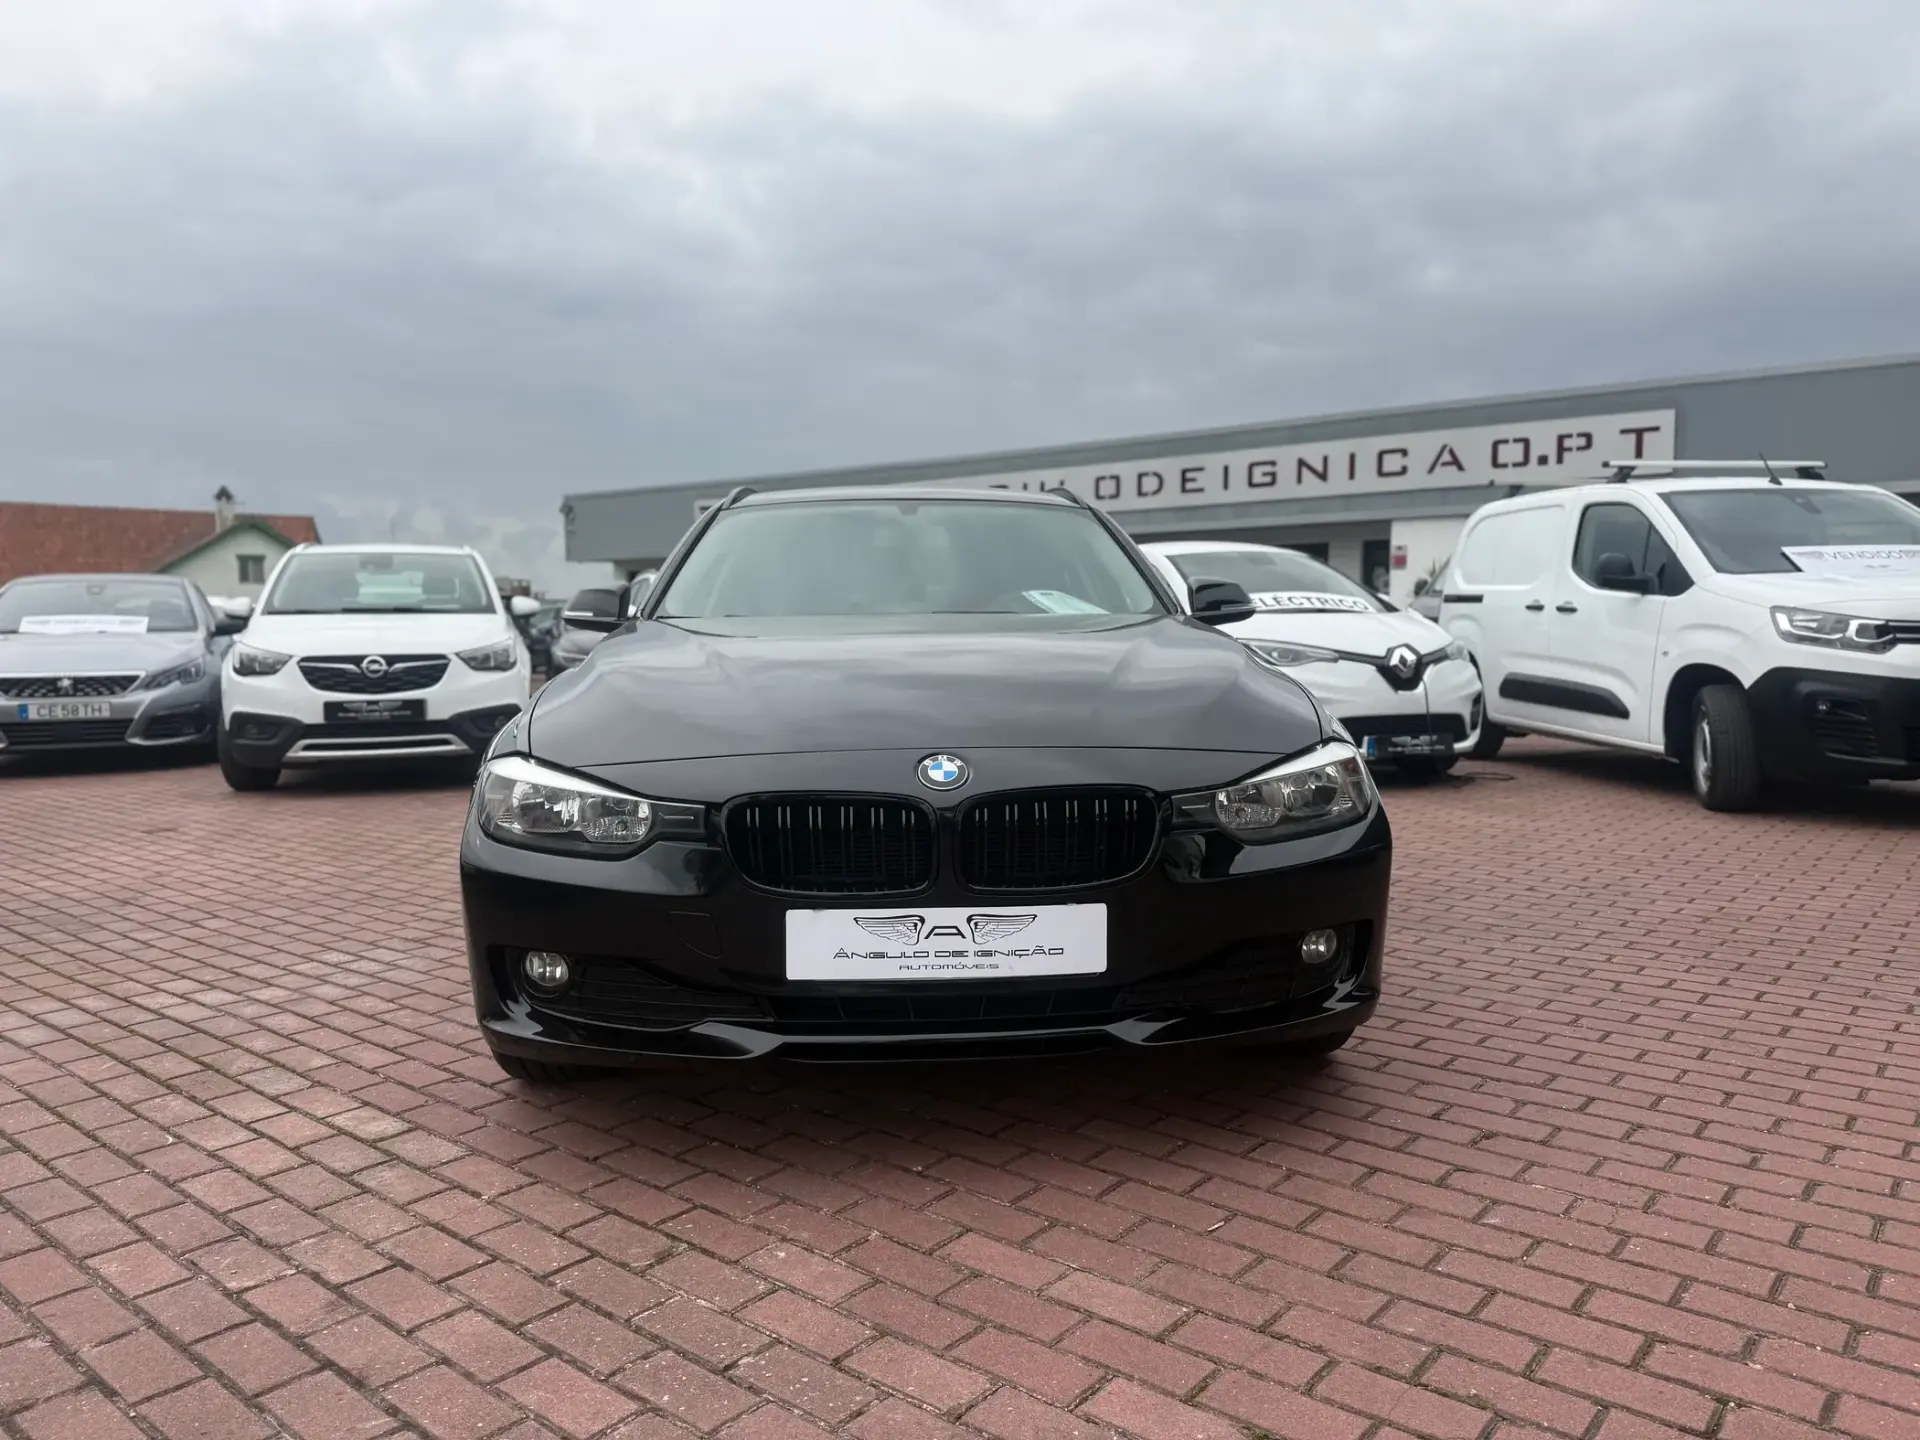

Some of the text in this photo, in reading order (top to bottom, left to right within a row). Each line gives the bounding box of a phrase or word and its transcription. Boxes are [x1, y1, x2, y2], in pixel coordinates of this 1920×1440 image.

[36, 704, 102, 718] CE 58 TH
[923, 755, 963, 767] BMW
[833, 945, 1064, 960] ÂNGULO DE IGNIÇÃO
[898, 962, 1000, 971] AUTOMÓVEIS
